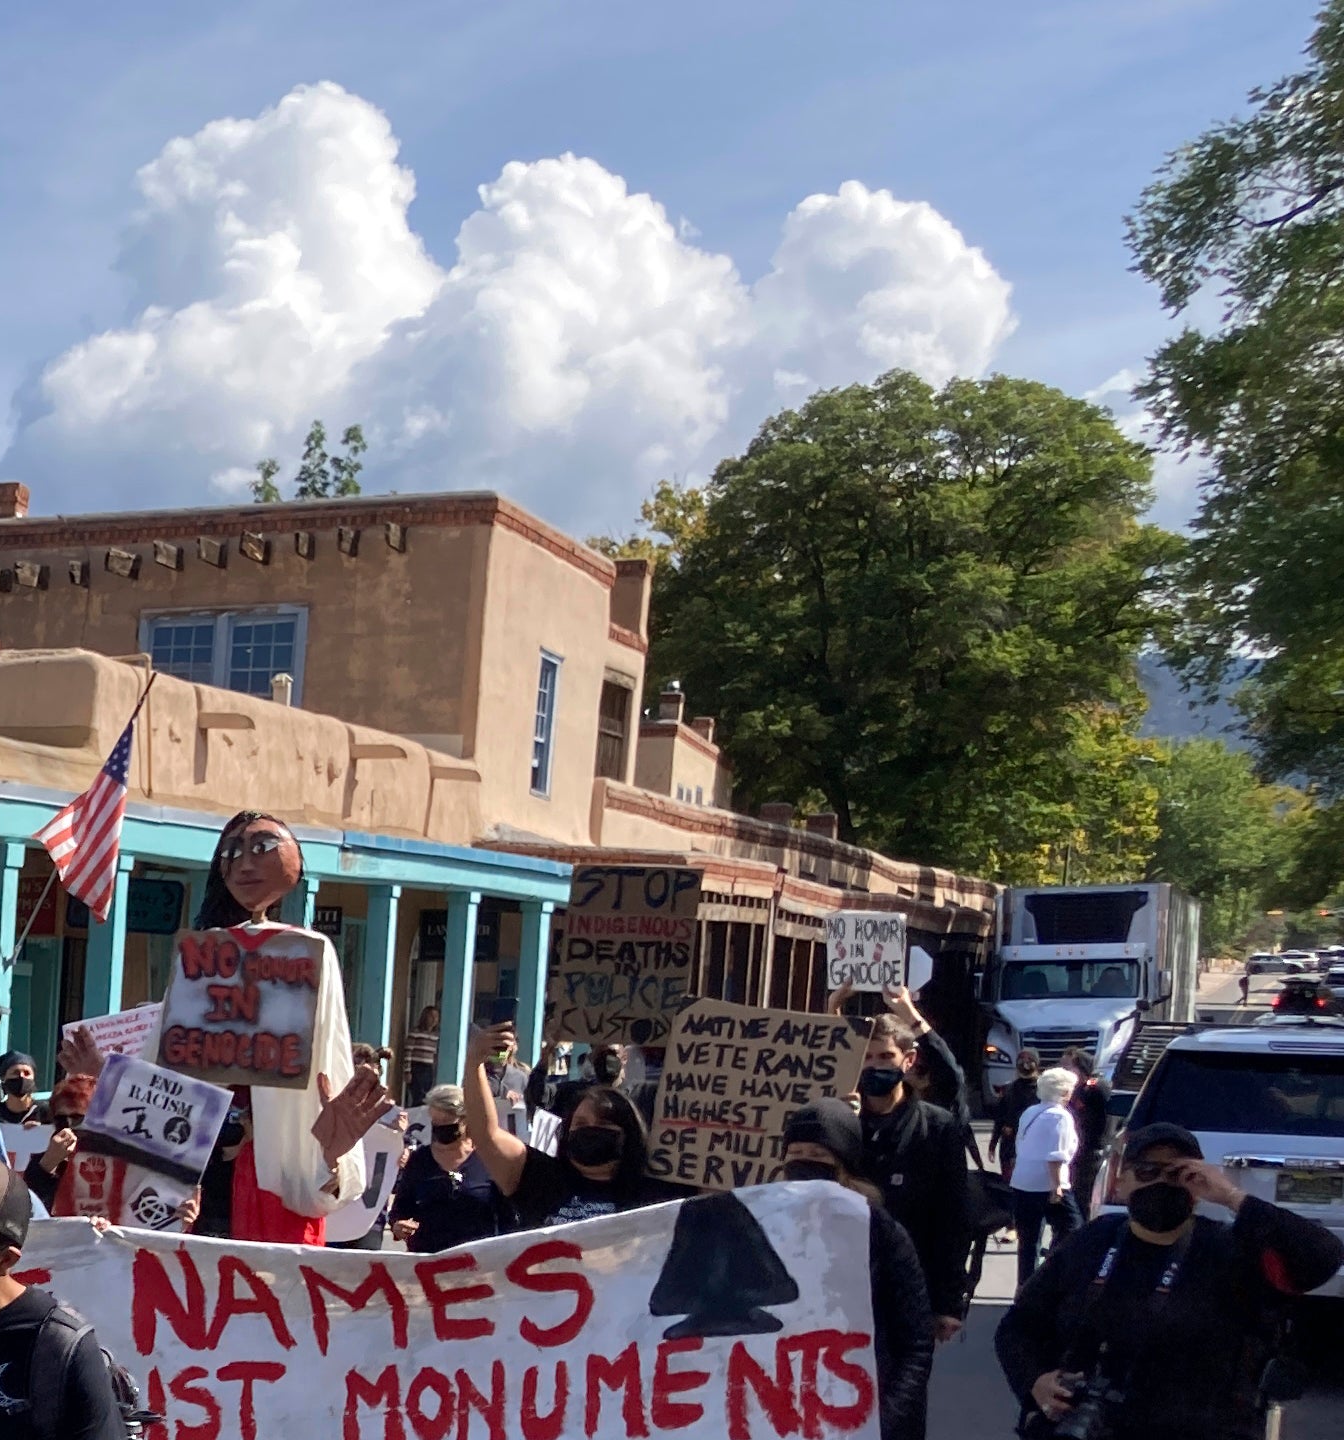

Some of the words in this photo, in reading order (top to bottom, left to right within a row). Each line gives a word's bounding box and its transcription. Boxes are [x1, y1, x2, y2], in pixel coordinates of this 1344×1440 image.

[571, 866, 700, 913] STOP
[566, 914, 692, 941] INDIGENOUS
[827, 918, 846, 940] NO
[179, 935, 241, 980] NO
[566, 937, 691, 970] DEATHS
[850, 943, 865, 958] IN
[615, 961, 642, 977] IN
[829, 957, 902, 987] GENOCIDE
[203, 983, 261, 1025] IN
[563, 970, 688, 1010] POLICE
[560, 1006, 673, 1046] CUSTOD
[680, 1013, 771, 1040] NATIVE
[772, 1019, 852, 1051] AMER
[164, 1025, 304, 1077] GENOCIDE
[127, 1084, 194, 1118] RACISM
[148, 1073, 194, 1097] END
[665, 1072, 728, 1096] HAVE
[740, 1078, 812, 1105] HAVE
[663, 1093, 770, 1128] HIGHEST
[659, 1127, 697, 1153] OF
[130, 1239, 596, 1357] NAMES
